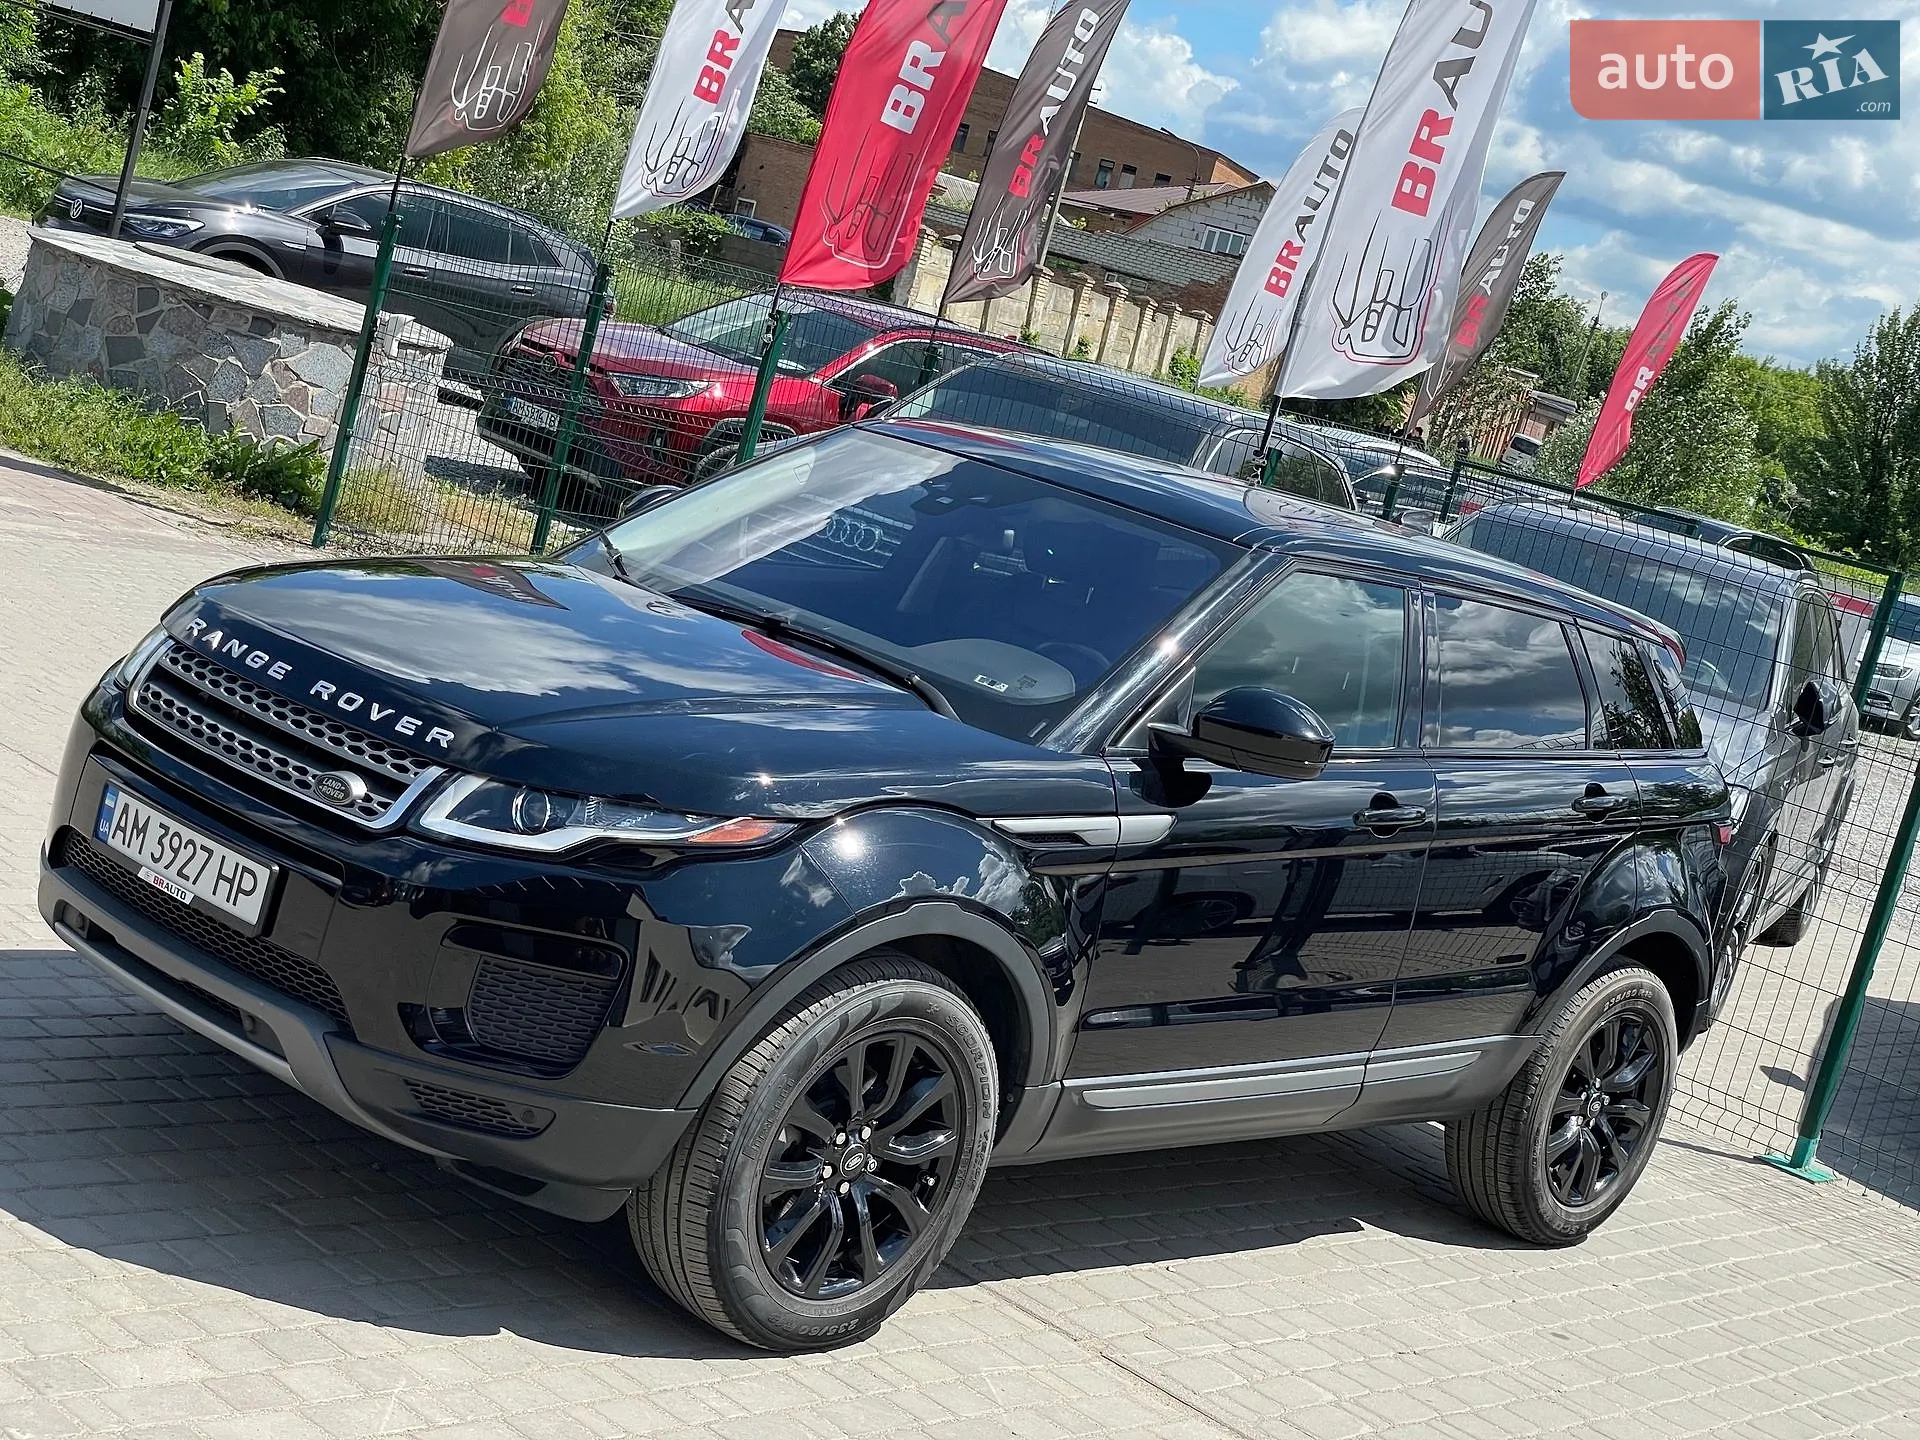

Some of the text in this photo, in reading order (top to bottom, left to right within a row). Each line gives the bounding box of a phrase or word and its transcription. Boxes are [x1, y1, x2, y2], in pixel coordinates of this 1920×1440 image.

[1009, 7, 1100, 199] BRAUTO
[1391, 0, 1494, 217] BRAU
[1263, 128, 1354, 299] BRAUTO
[186, 617, 455, 749] RANGE ROVER
[99, 819, 109, 833] UA
[321, 785, 345, 800] ROVER
[323, 777, 342, 790] LAND
[111, 802, 258, 907] AM 3927 HP
[152, 874, 187, 901] BRAUTO
[945, 1015, 992, 1119] SCORPION
